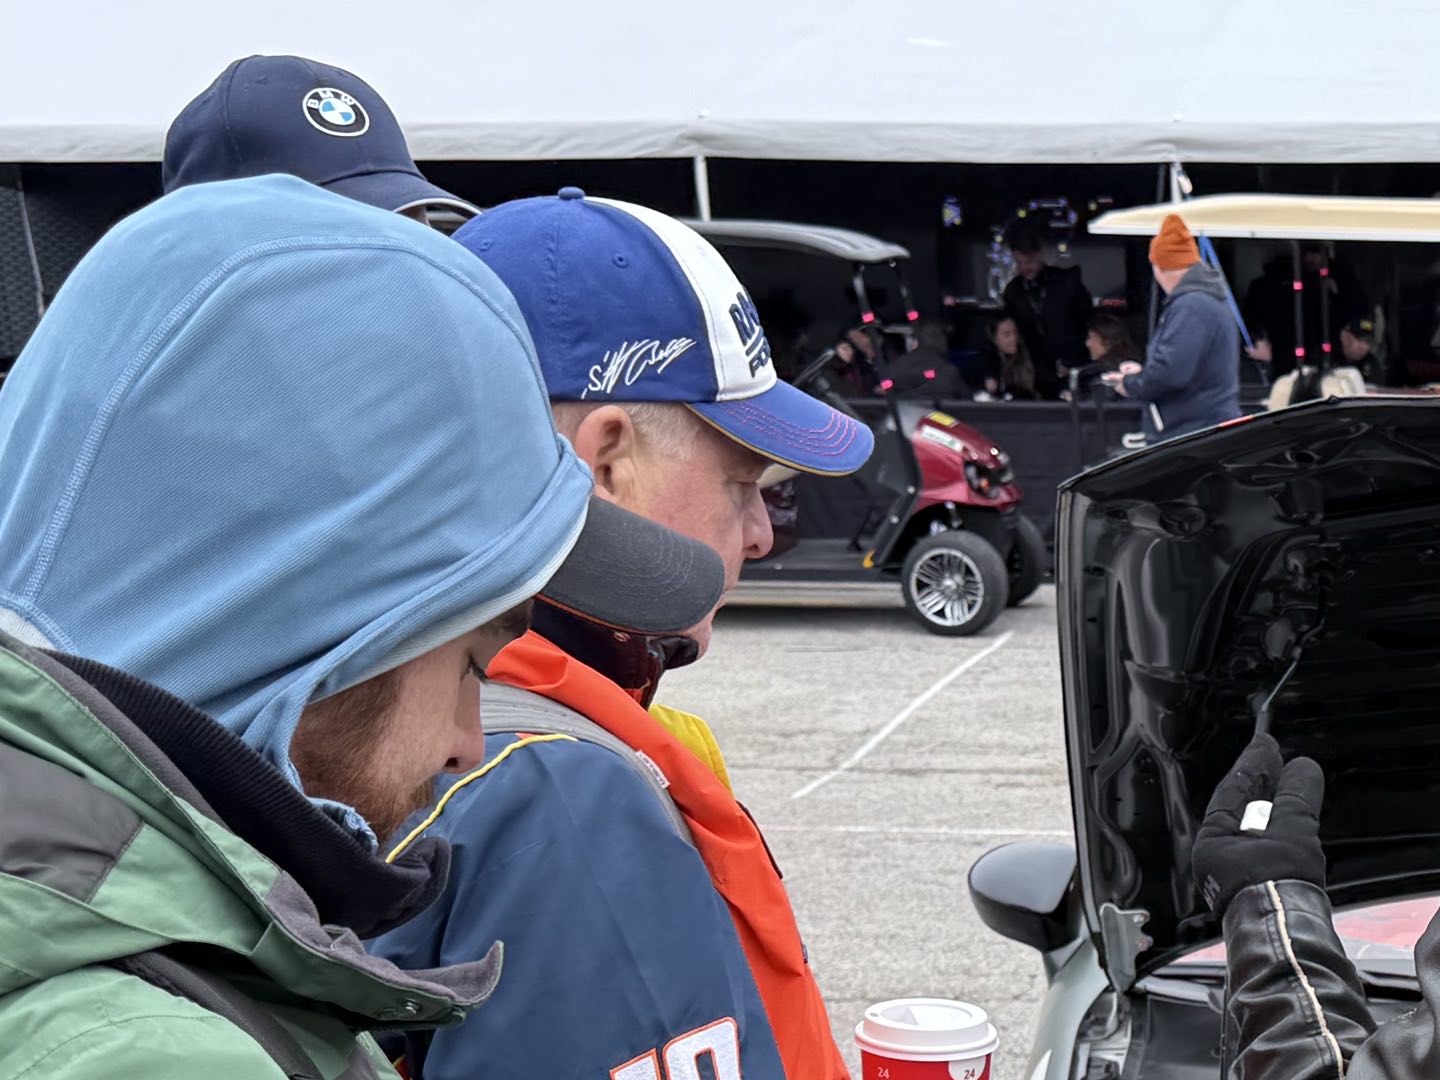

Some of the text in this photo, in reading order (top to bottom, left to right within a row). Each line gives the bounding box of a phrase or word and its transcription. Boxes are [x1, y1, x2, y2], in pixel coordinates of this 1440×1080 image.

[307, 89, 355, 109] BMW
[877, 1066, 890, 1079] 24
[963, 1068, 976, 1080] 24
